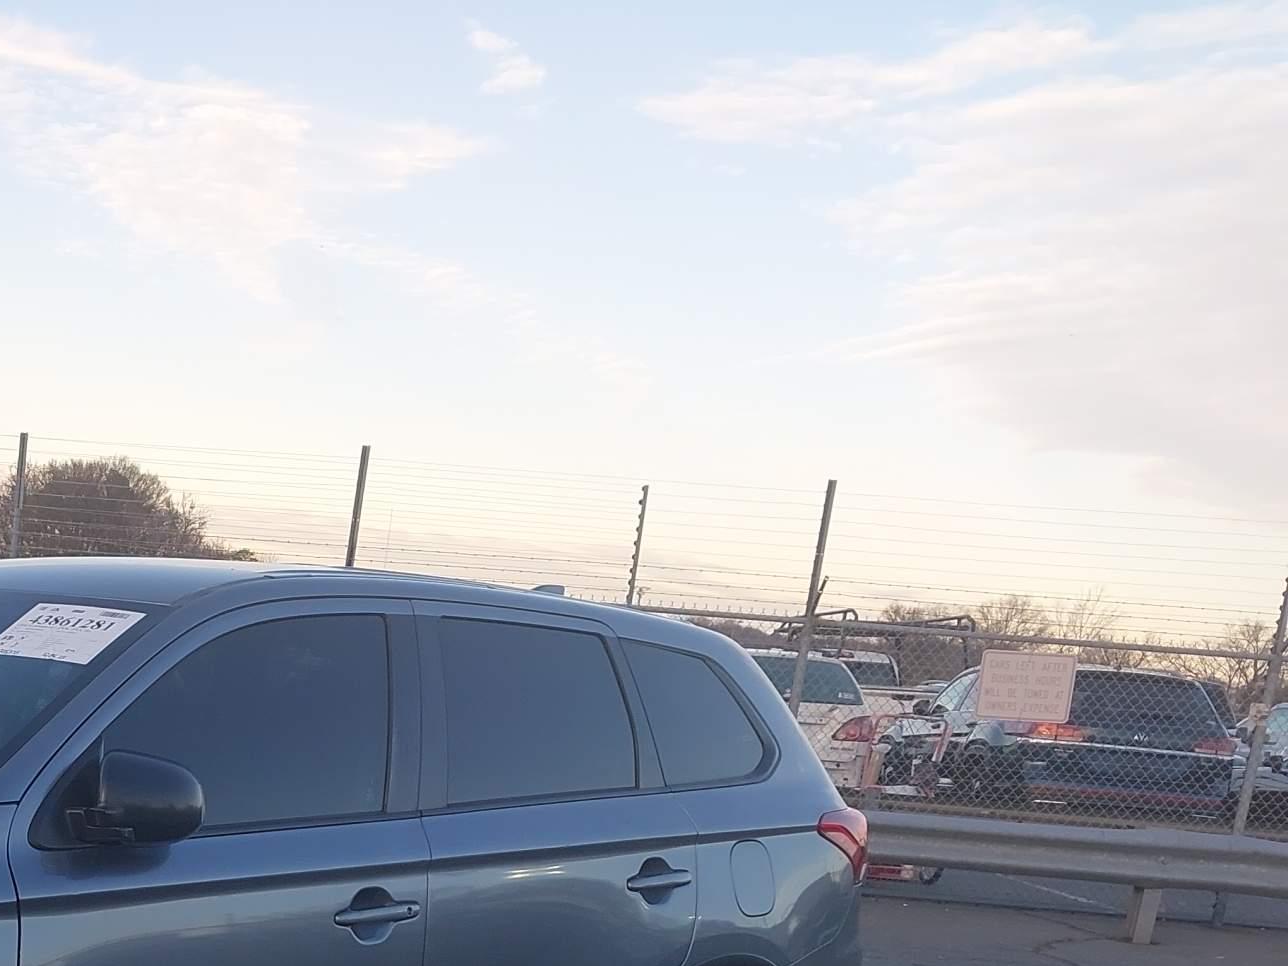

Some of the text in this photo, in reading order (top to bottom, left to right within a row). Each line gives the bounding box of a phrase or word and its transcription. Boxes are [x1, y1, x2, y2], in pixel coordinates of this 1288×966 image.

[28, 614, 116, 631] 43861281
[1016, 661, 1035, 671] LEFT
[1040, 663, 1068, 673] AFTER
[1024, 689, 1049, 699] TOWED
